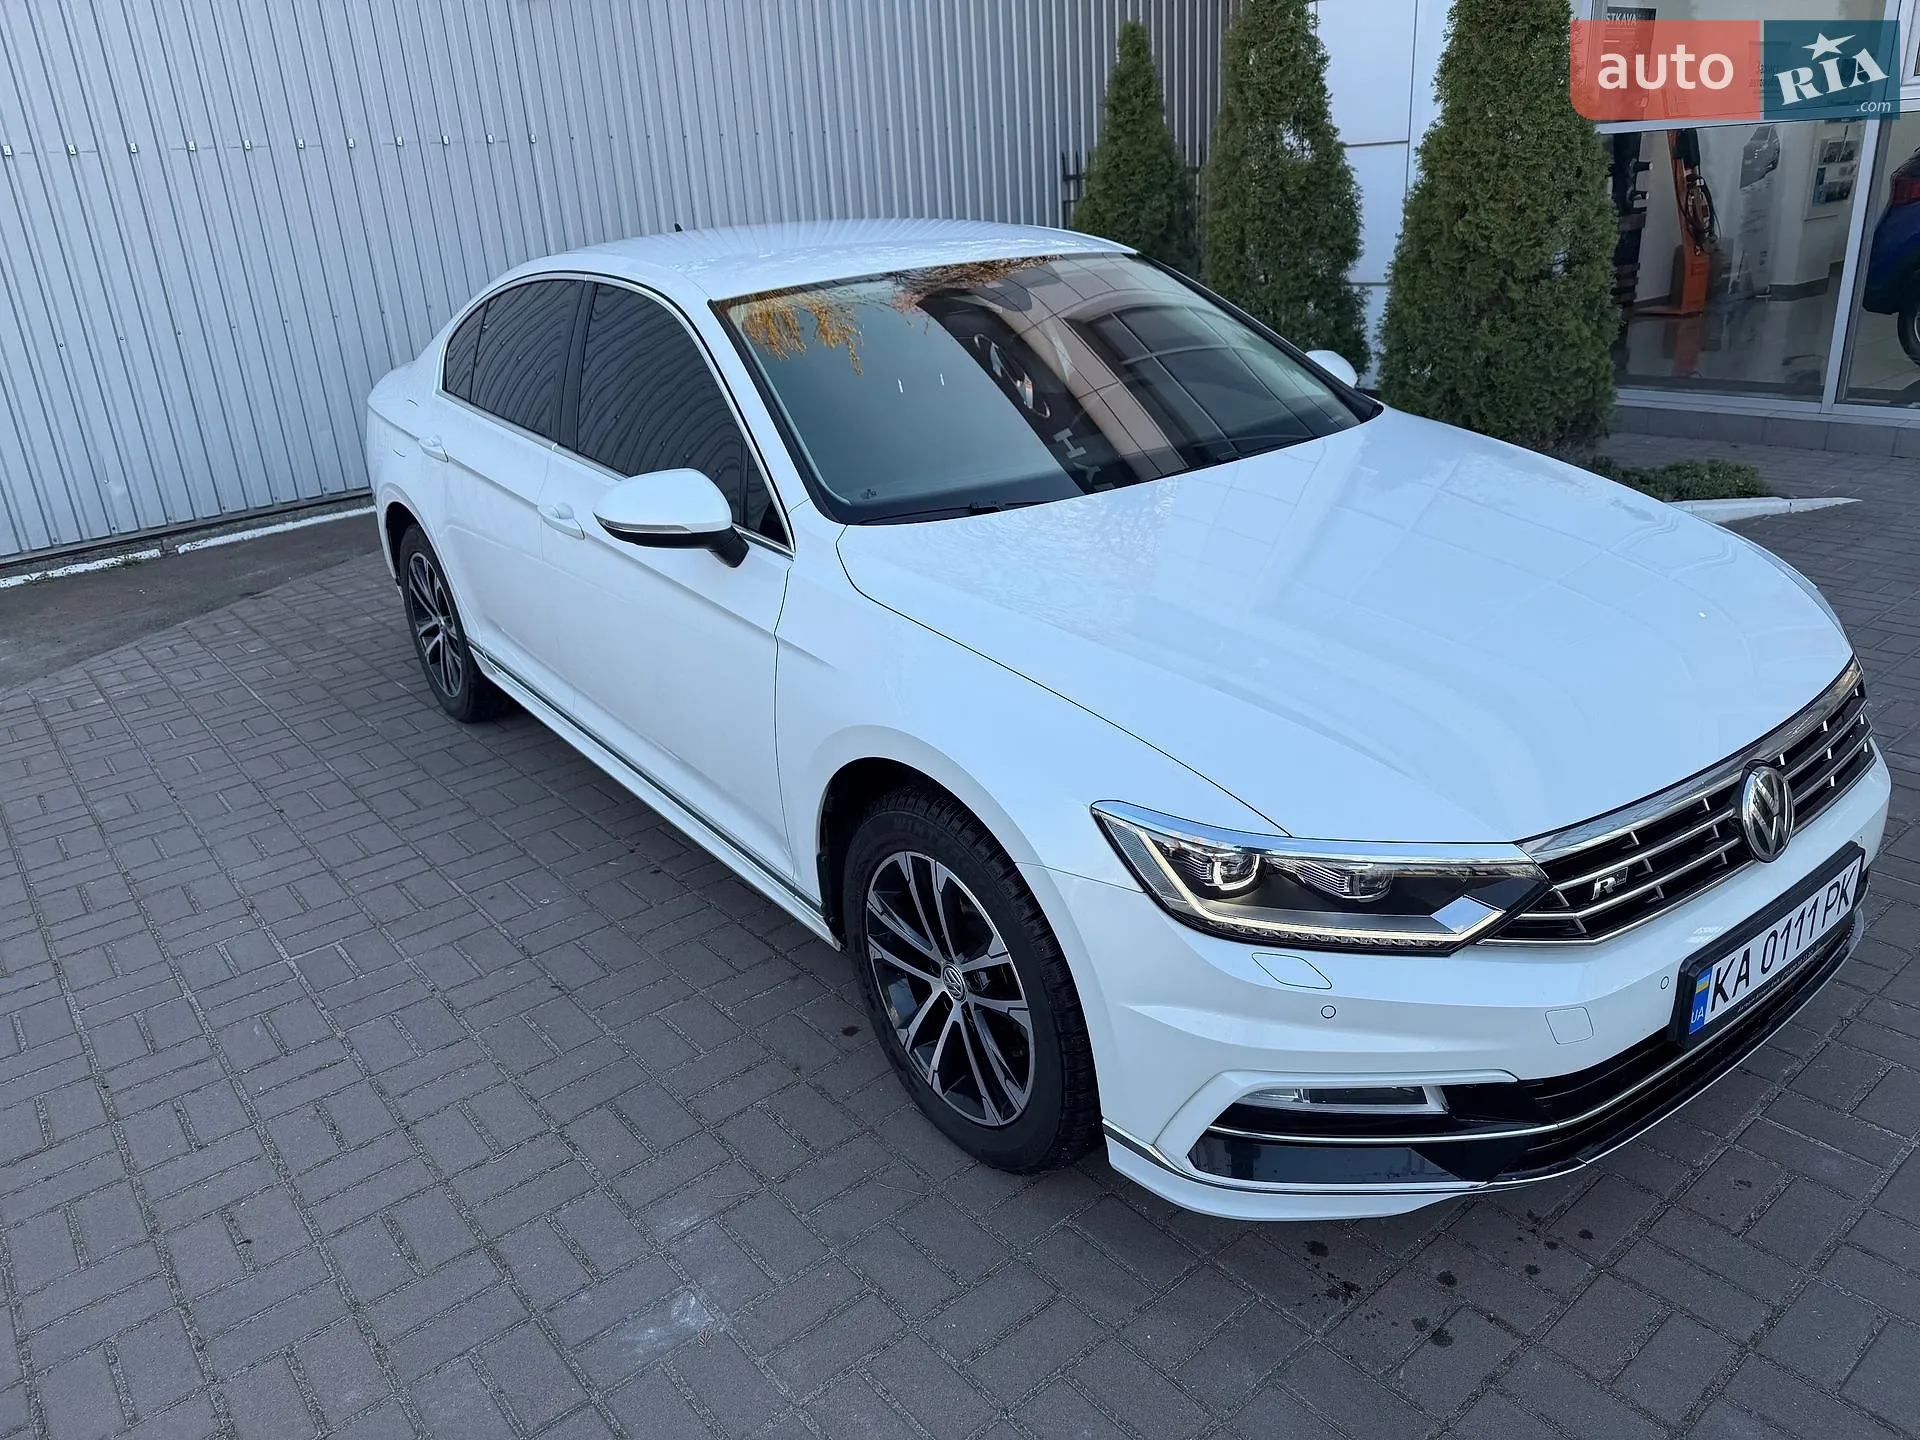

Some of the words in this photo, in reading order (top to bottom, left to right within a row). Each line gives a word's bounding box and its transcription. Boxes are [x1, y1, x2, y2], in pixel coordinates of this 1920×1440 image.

[1690, 1006, 1704, 1024] UA
[1711, 947, 1750, 1012] KA
[1761, 896, 1819, 974] 0111
[1822, 866, 1856, 928] PK
